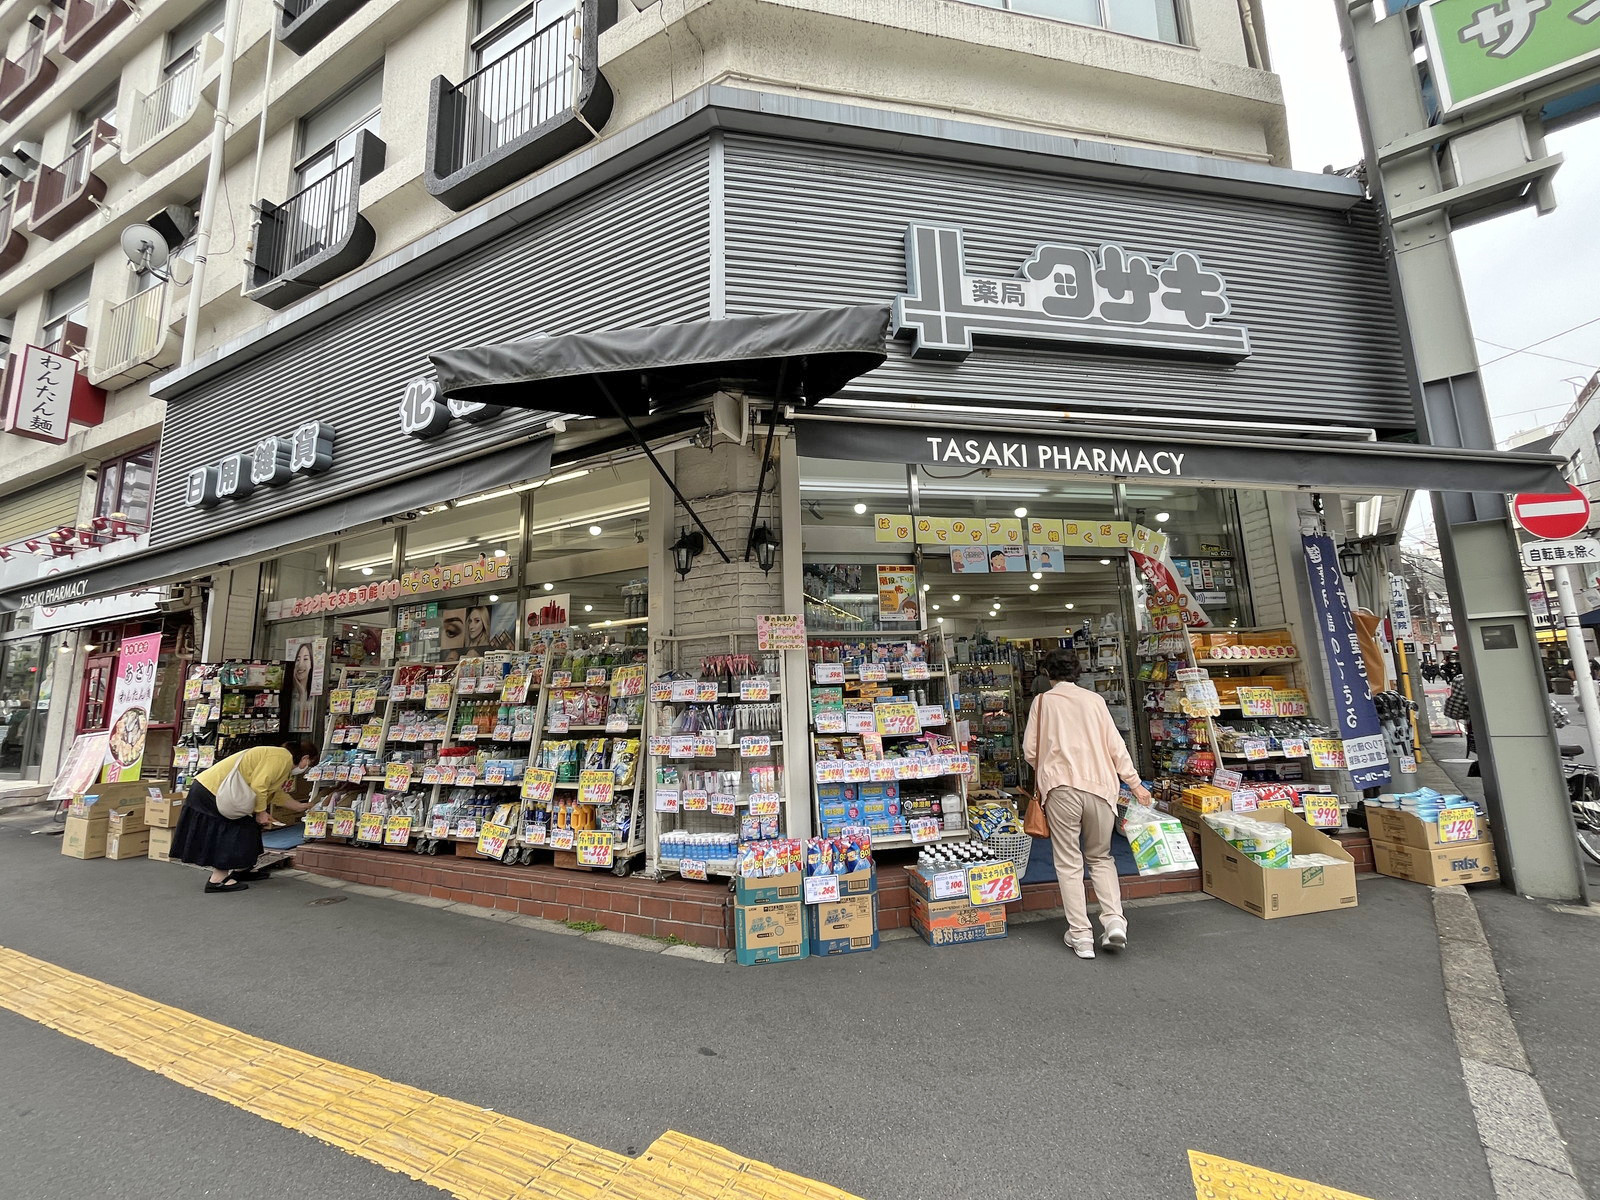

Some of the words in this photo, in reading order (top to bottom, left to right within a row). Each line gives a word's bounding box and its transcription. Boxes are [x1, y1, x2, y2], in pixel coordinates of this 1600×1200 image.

[971, 279, 1026, 308] 薬局
[1026, 243, 1227, 329] タサキ
[29, 354, 63, 435] わんたん麺
[926, 436, 1029, 468] TASAKI
[1038, 444, 1185, 476] PHARMACY
[185, 419, 322, 508] 日用雑貨
[1529, 544, 1597, 562] 自転車を除く
[19, 589, 45, 609] TASAKI
[45, 579, 89, 603] PHARMACY
[125, 658, 154, 686] あさり
[624, 676, 642, 688] 188
[1255, 699, 1272, 709] 158
[1326, 750, 1345, 761] 158
[534, 781, 551, 793] 498
[591, 783, 611, 795] 1580
[720, 803, 734, 812] 328
[761, 801, 777, 810] 198
[1317, 807, 1338, 819] 990
[923, 826, 936, 834] 238
[1449, 819, 1473, 833] 120
[489, 836, 505, 849] 798
[590, 845, 610, 857] 328
[1451, 857, 1479, 872] FRISK
[821, 886, 835, 895] 268
[950, 881, 962, 889] 100
[987, 875, 1014, 894] 78
[995, 889, 1013, 901] 84
